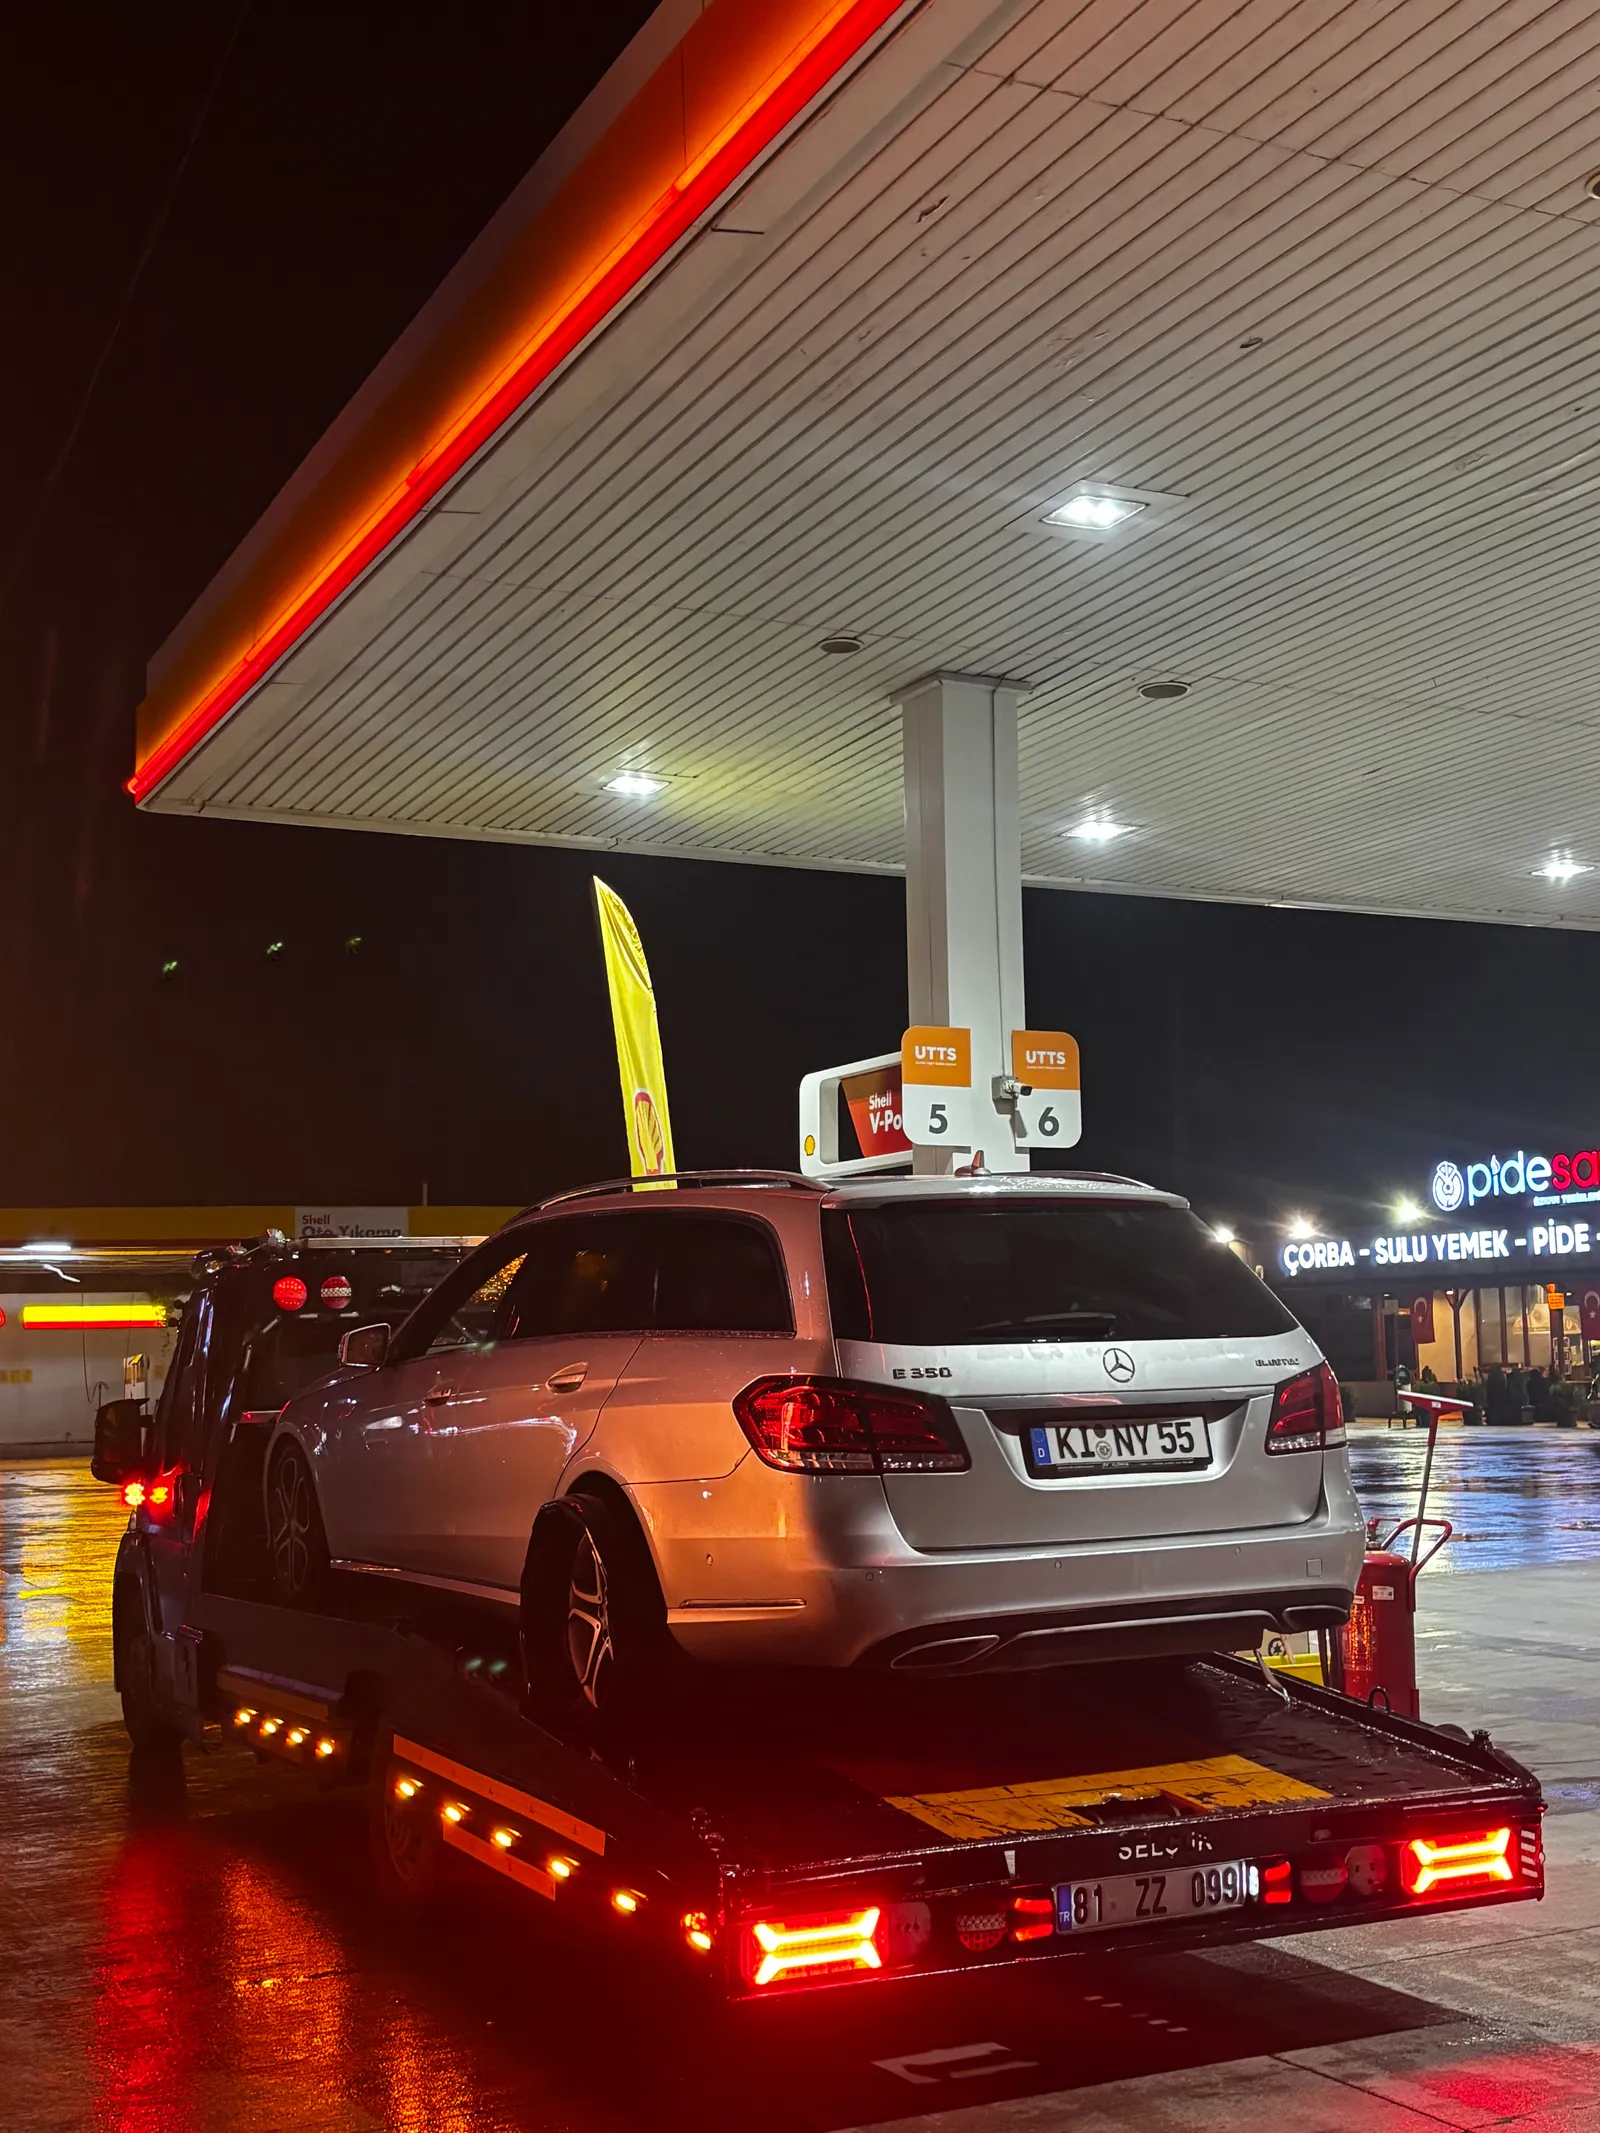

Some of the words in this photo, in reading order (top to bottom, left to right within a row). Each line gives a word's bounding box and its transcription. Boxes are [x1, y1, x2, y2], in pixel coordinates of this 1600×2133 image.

[915, 1045, 957, 1061] UTTS
[1025, 1050, 1066, 1065] UTTS
[868, 1089, 892, 1110] Shell
[929, 1104, 948, 1134] 5
[1038, 1107, 1060, 1137] 6
[302, 1214, 331, 1225] Shell
[1283, 1240, 1355, 1277] ÇORBA
[1375, 1236, 1428, 1265] SULU
[1431, 1229, 1510, 1261] YEMEK
[1533, 1218, 1592, 1256] PİDE
[892, 1368, 907, 1380] E
[910, 1367, 953, 1379] 350
[1038, 1448, 1045, 1458] D
[1055, 1425, 1096, 1459] KI
[1112, 1424, 1150, 1457] NY
[1157, 1421, 1195, 1454] 55
[1059, 1911, 1070, 1922] TR
[1073, 1884, 1103, 1924] 81
[1135, 1876, 1167, 1917] ZZ
[1191, 1867, 1238, 1909] 099
